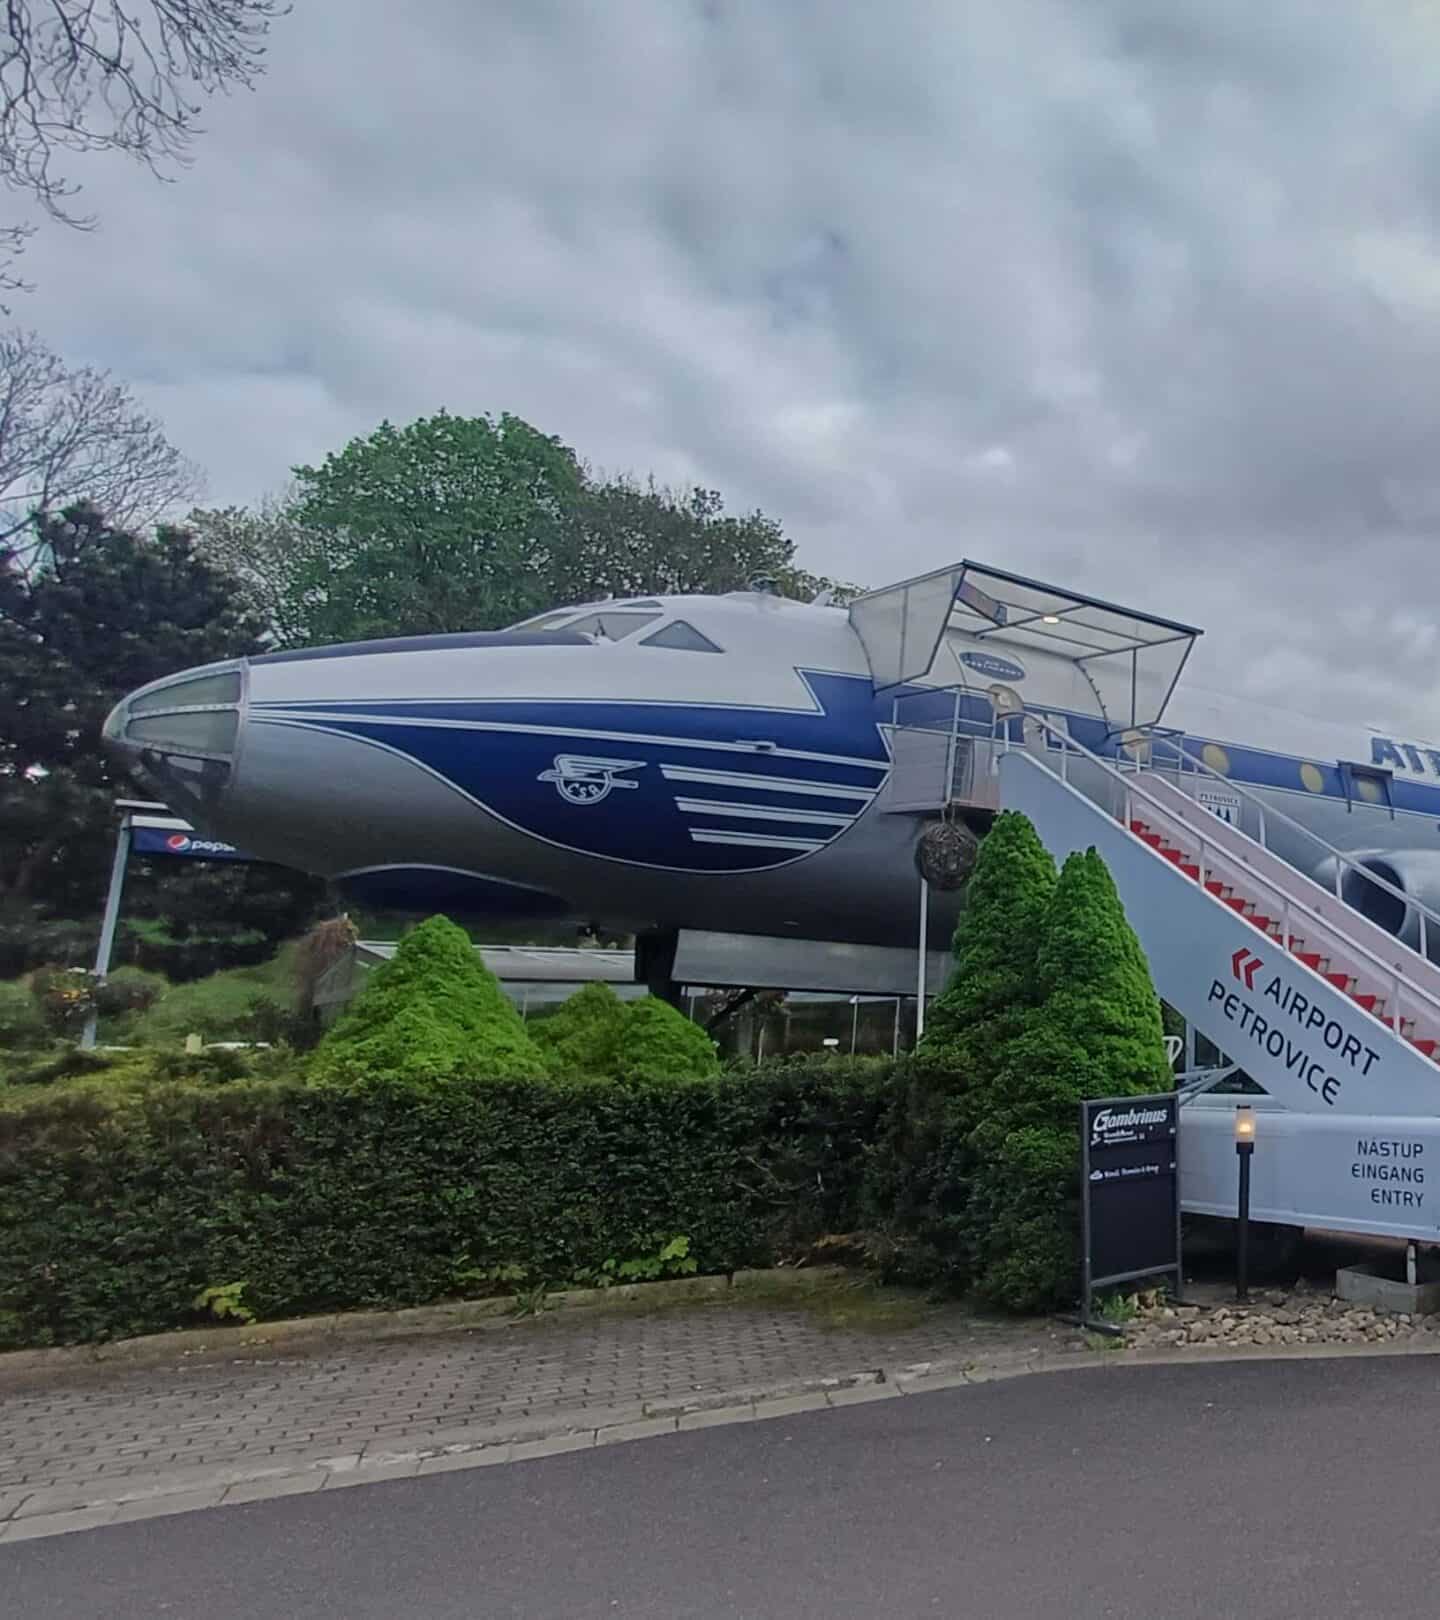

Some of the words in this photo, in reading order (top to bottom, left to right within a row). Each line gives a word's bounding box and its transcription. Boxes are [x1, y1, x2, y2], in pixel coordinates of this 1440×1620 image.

[191, 840, 237, 852] peps
[1263, 976, 1381, 1077] AIRPORT
[1207, 978, 1342, 1106] PETROVICE
[1092, 1107, 1168, 1132] Gambrinus
[1351, 1163, 1424, 1183] EINGANG
[1371, 1188, 1425, 1208] ENTRY
